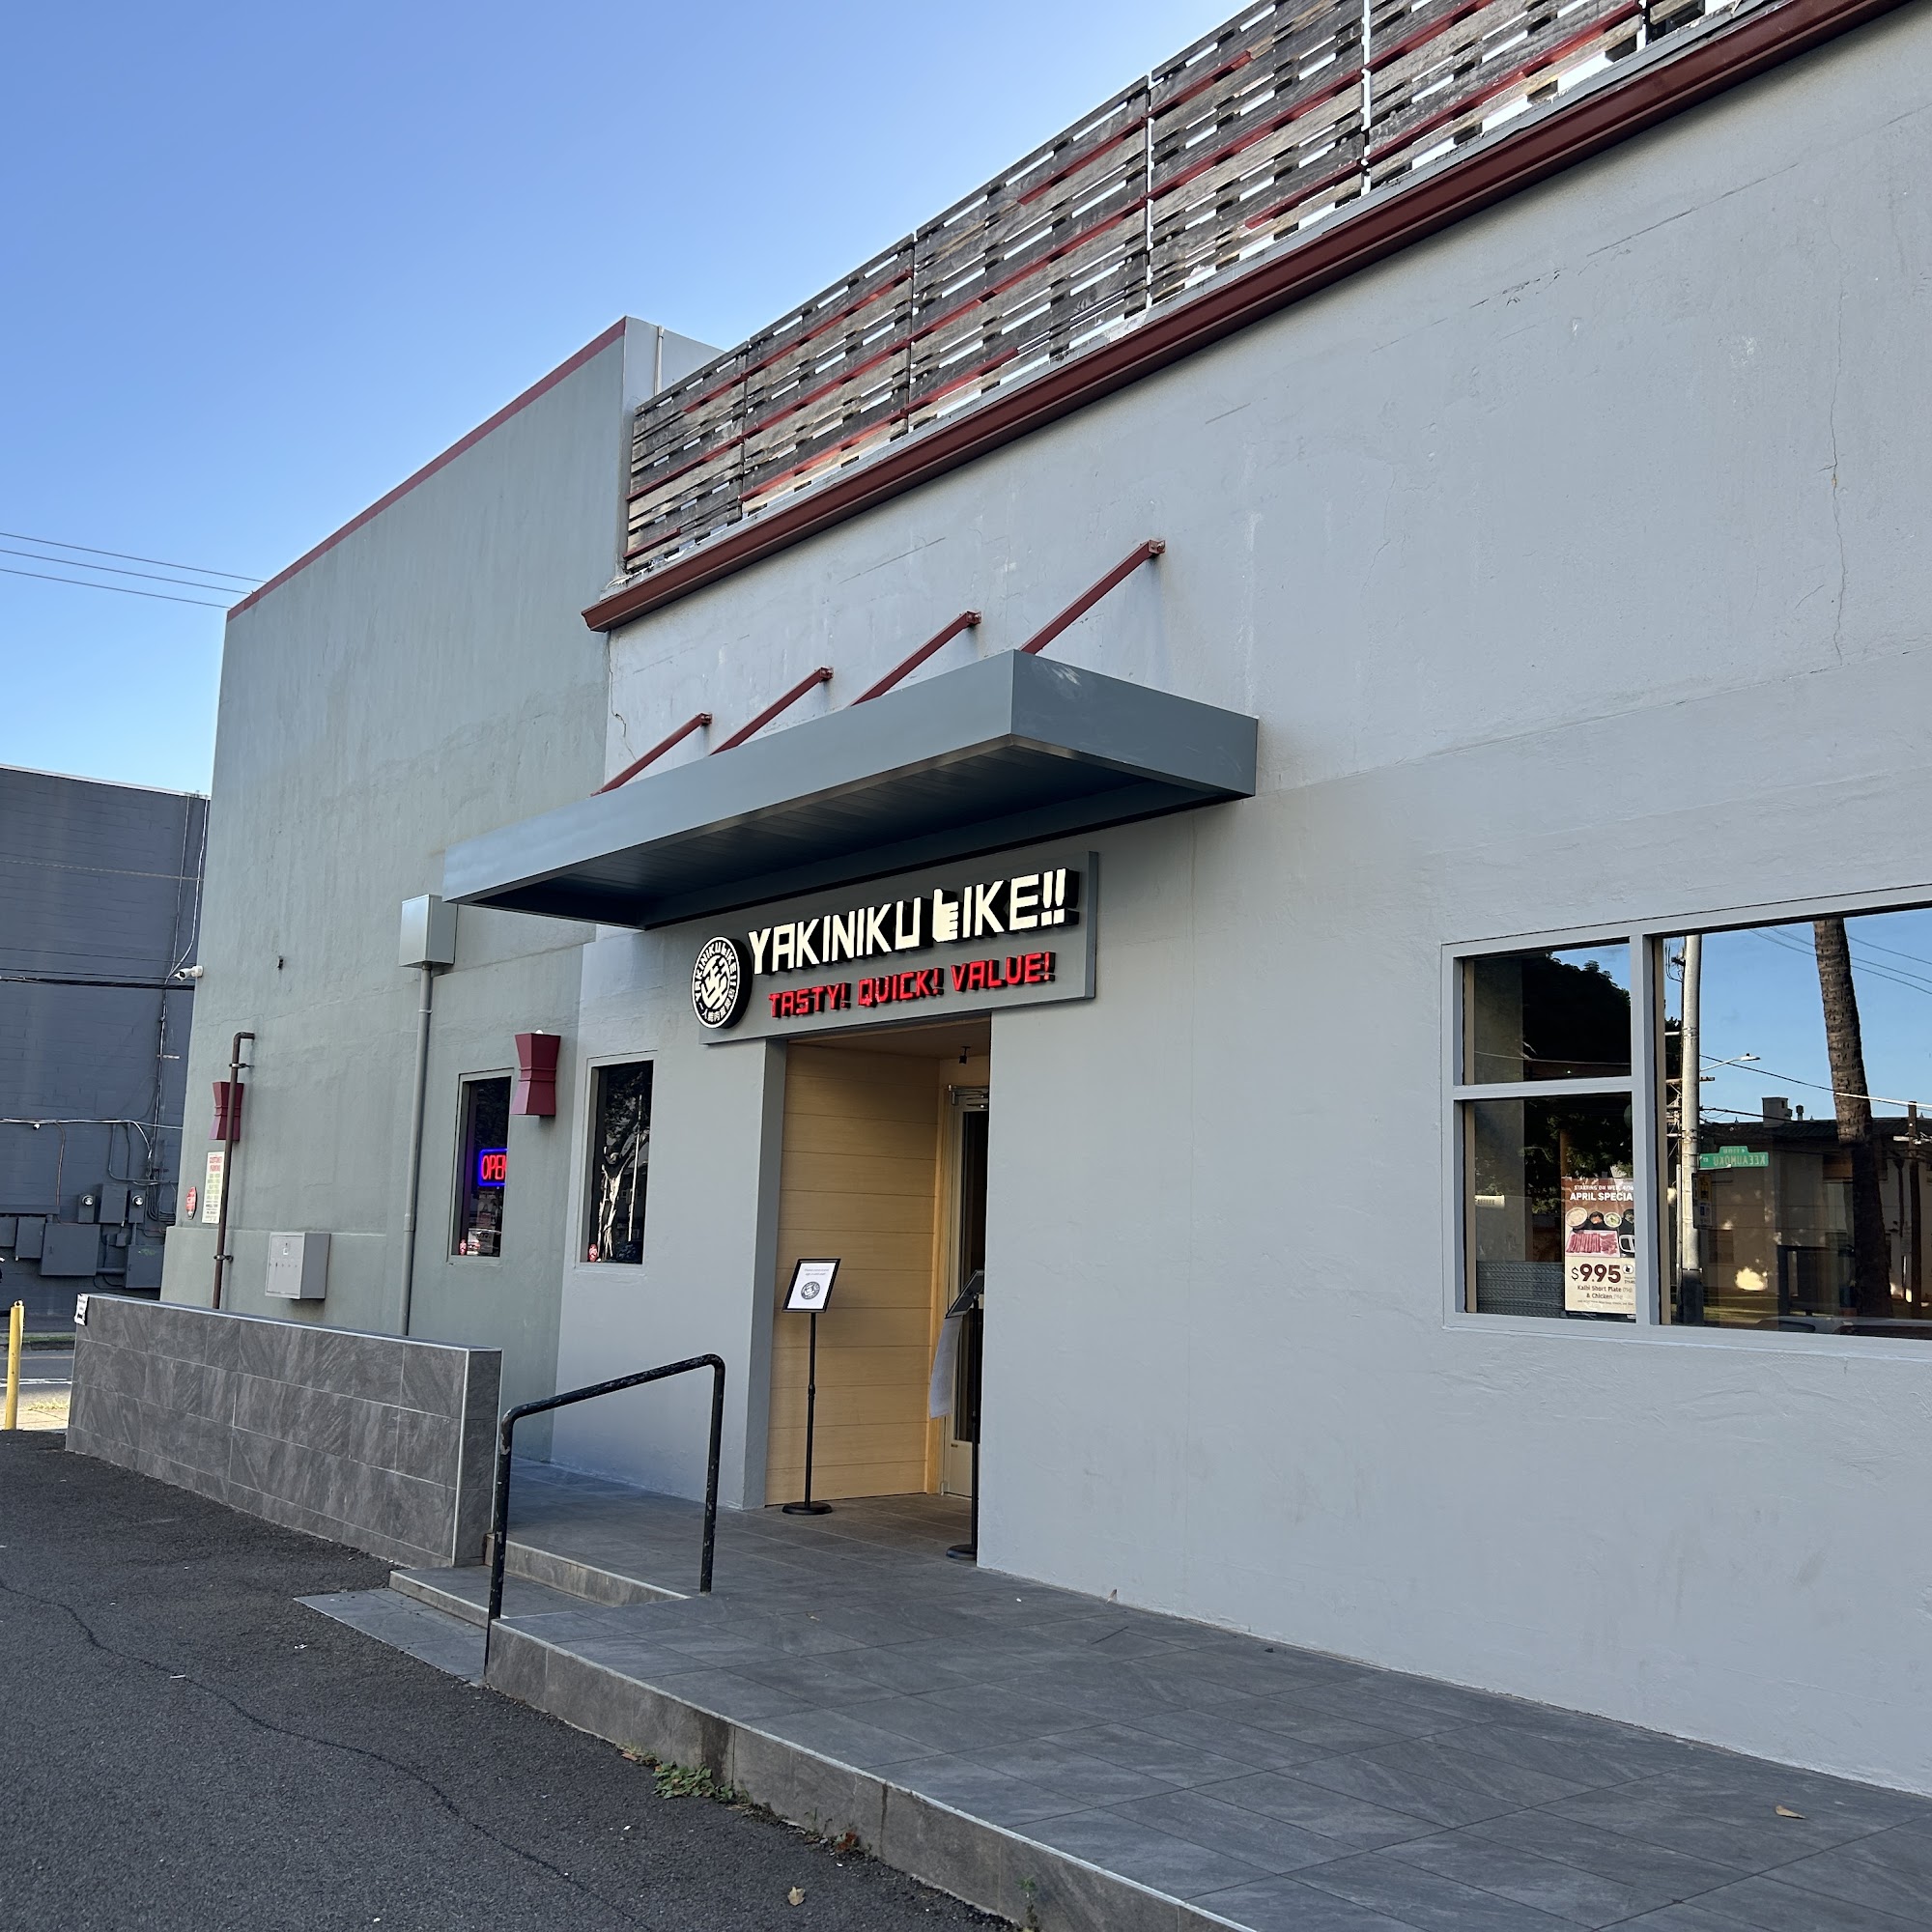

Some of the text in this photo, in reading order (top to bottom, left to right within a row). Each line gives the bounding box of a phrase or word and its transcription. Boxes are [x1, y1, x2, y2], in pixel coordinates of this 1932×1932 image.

[748, 897, 923, 975] YAKINIKU
[769, 952, 1056, 1018] TASTY! QUICK! VALUE!
[1570, 1192, 1597, 1202] APRIL
[1571, 1263, 1622, 1284] $9.95
